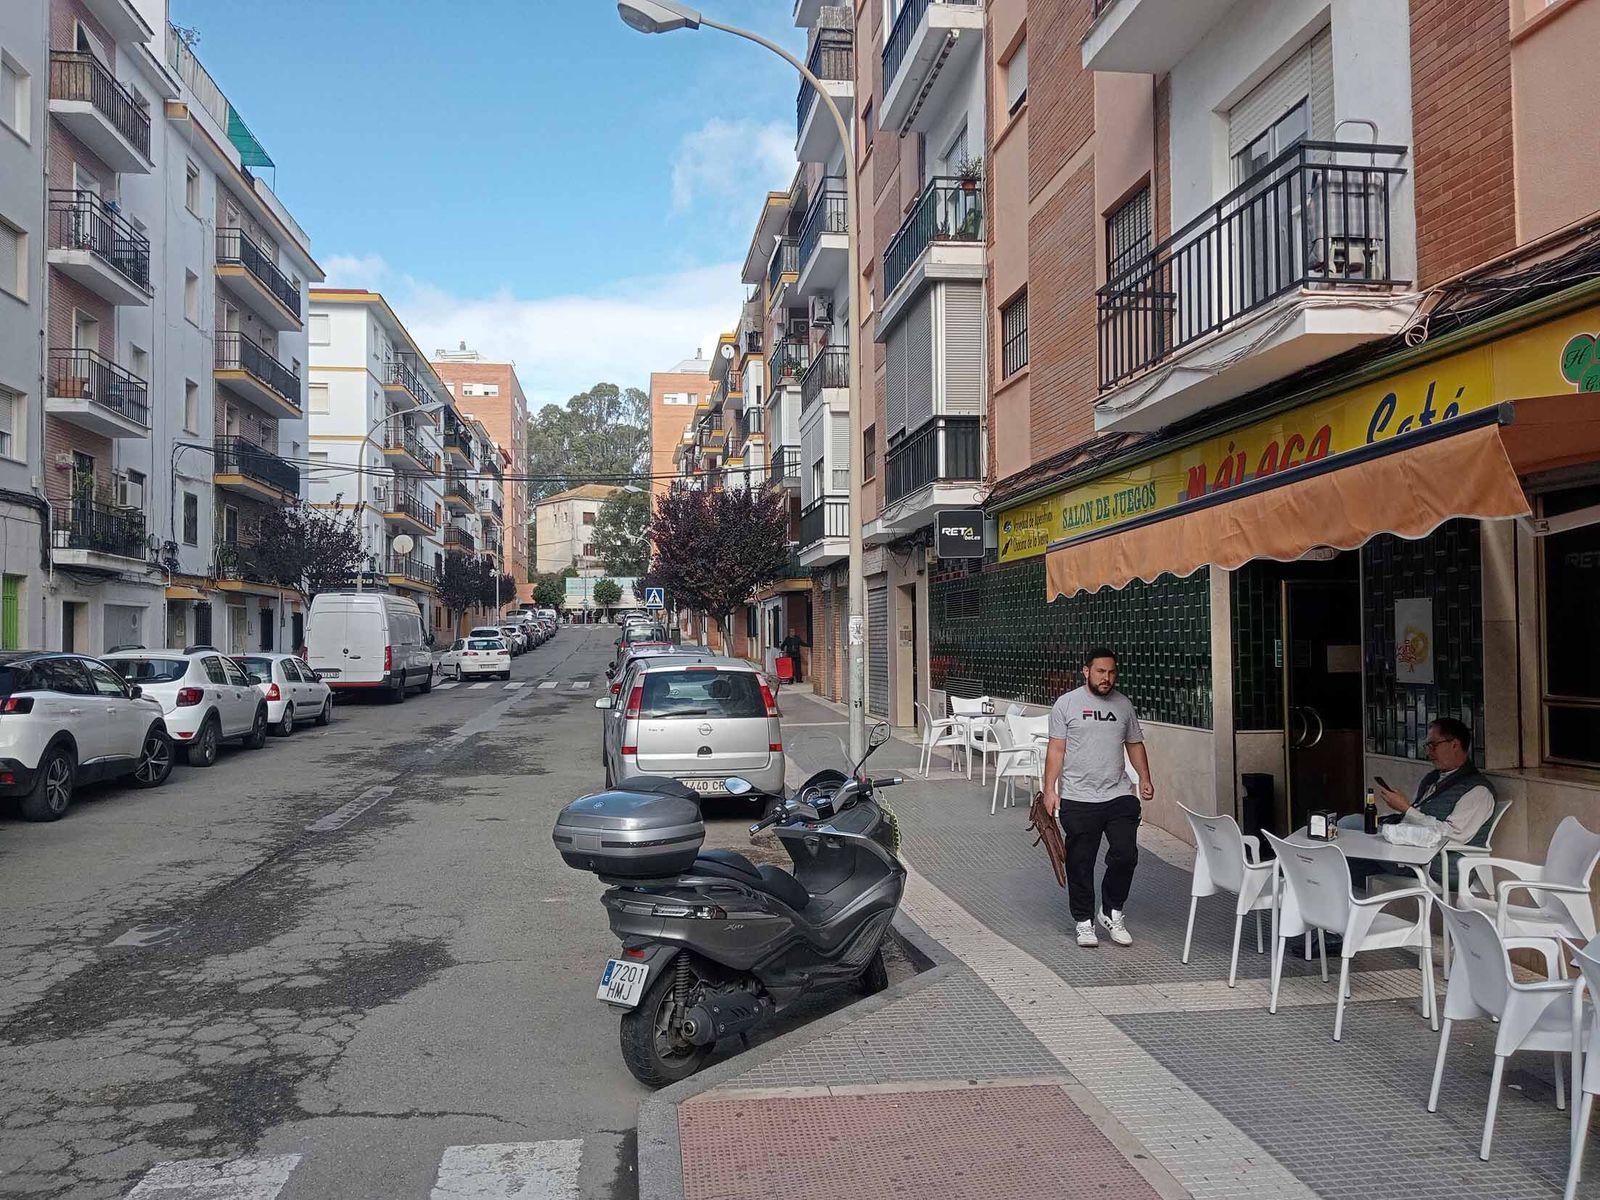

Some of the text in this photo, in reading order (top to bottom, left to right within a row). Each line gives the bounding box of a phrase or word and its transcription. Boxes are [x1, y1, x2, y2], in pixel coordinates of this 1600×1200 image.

[1062, 480, 1157, 530] SALON DE JUEGOS
[941, 527, 973, 536] RETA
[1082, 710, 1117, 721] FILA
[612, 963, 645, 984] 7201
[606, 981, 632, 1001] HMJ
